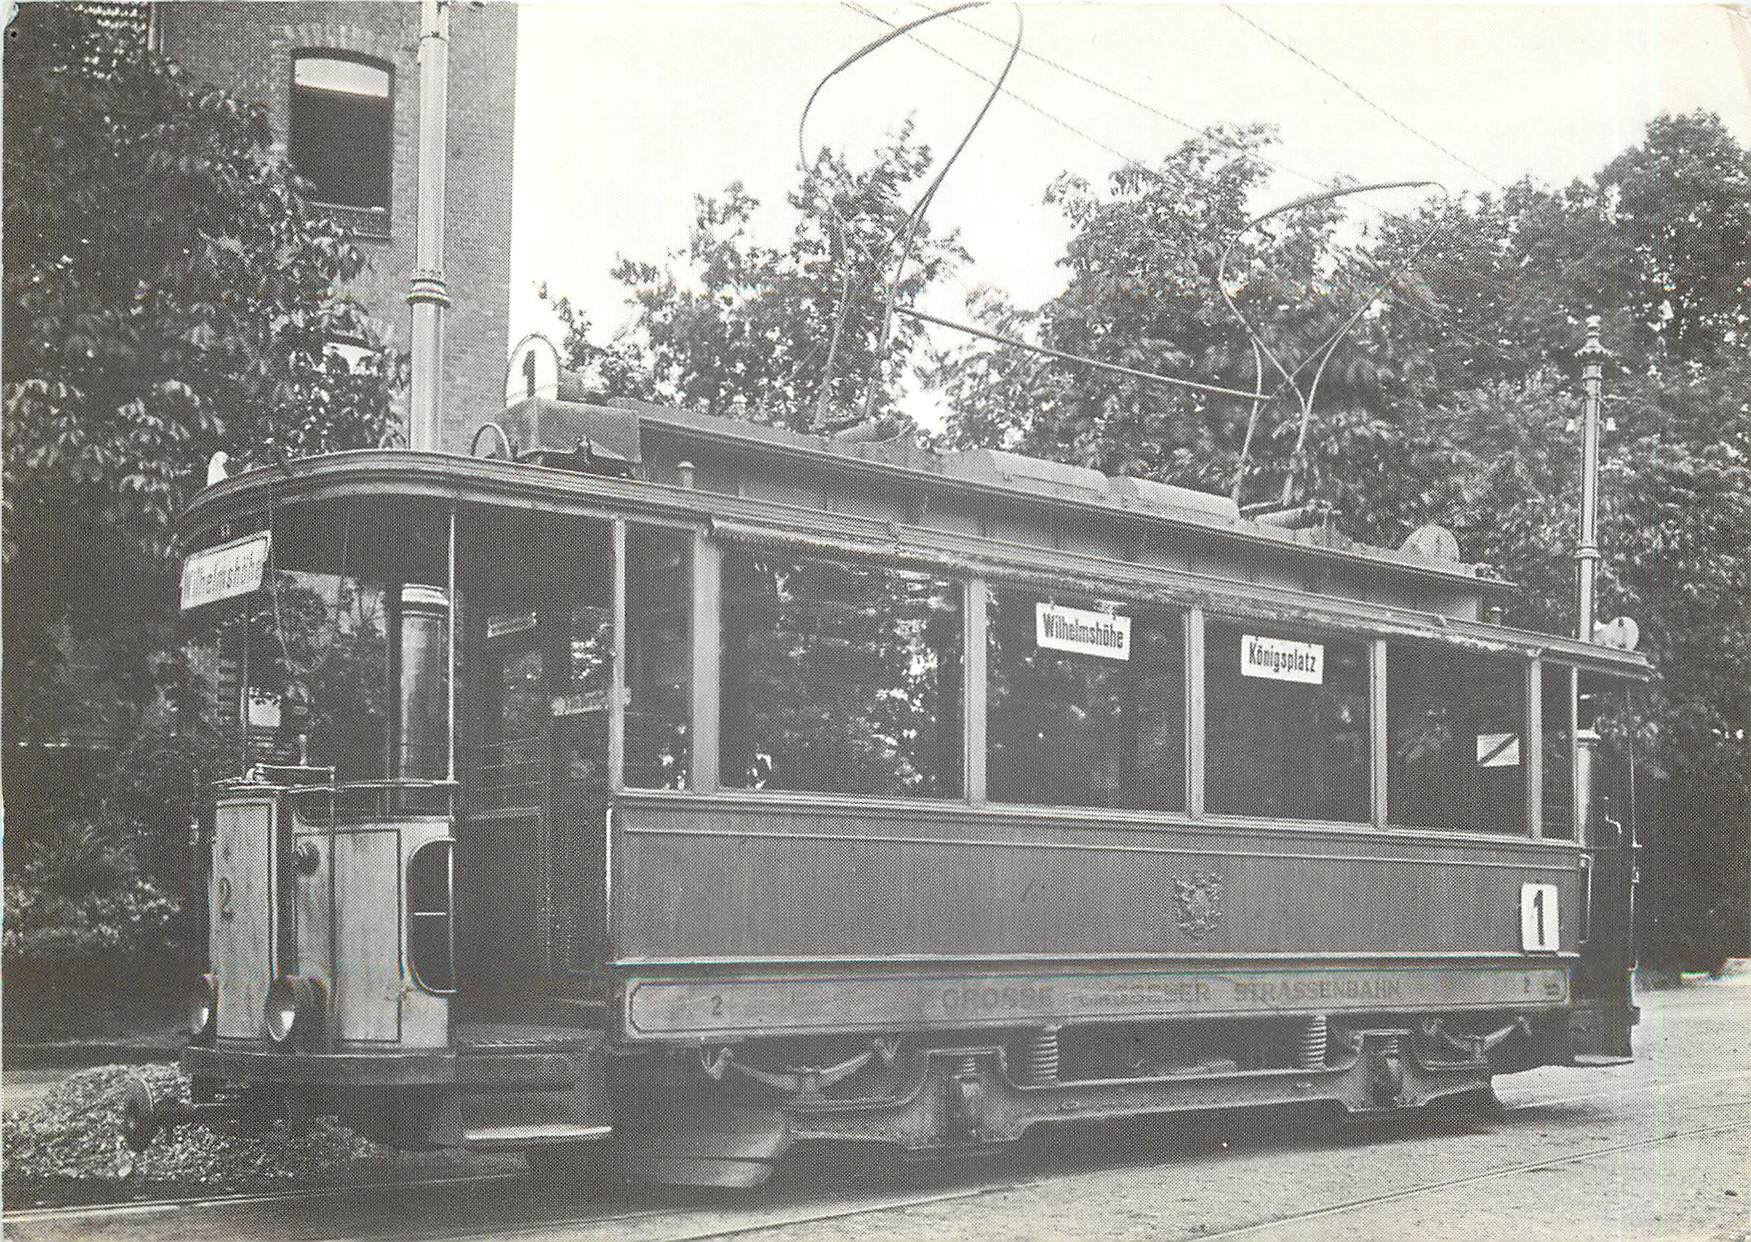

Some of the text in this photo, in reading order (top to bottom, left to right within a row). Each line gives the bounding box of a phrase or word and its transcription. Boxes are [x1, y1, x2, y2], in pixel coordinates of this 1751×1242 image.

[522, 349, 535, 398] 1
[1042, 613, 1124, 649] Wilhelmshöhe
[1248, 642, 1316, 673] Königsplatz
[219, 876, 234, 922] 2
[1533, 889, 1545, 946] 1
[711, 994, 723, 1017] 2
[942, 986, 1054, 1010] GROSSE
[1233, 979, 1401, 1002] STRASSENBAHN
